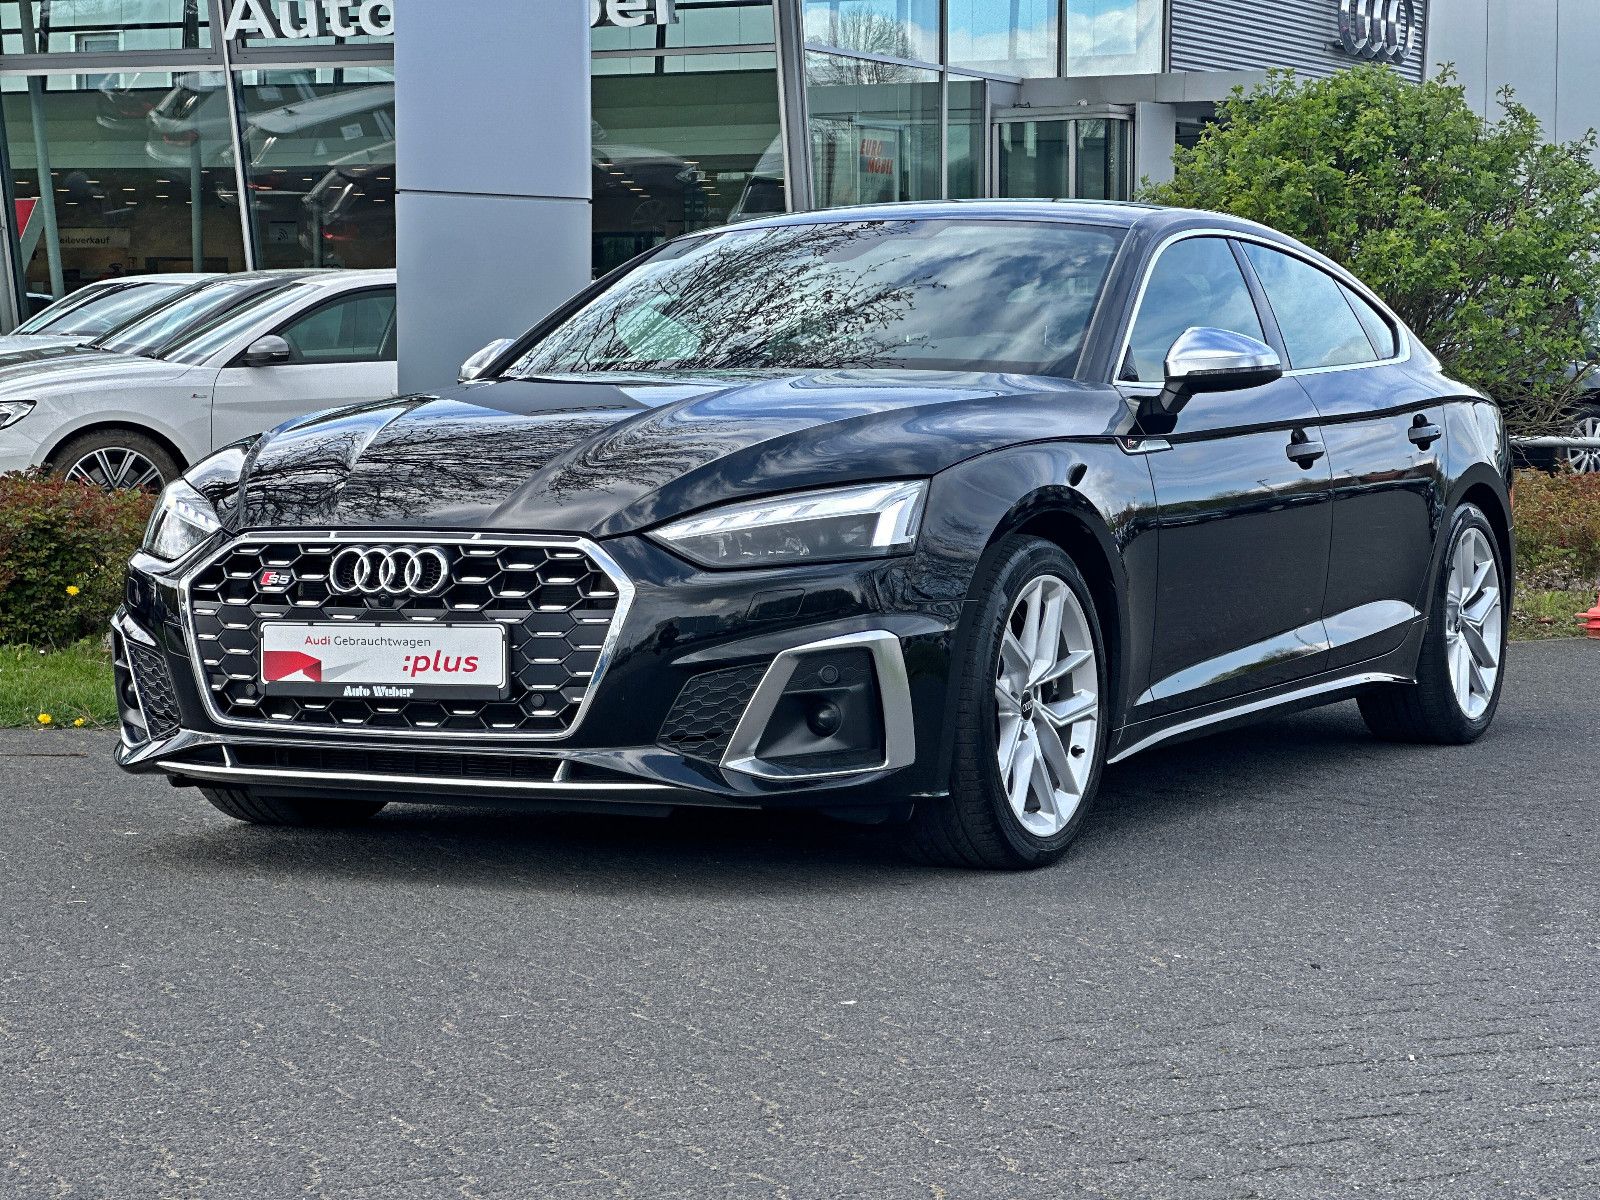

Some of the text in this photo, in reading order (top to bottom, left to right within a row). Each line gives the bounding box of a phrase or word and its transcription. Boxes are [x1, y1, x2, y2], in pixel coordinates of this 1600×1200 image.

[223, 0, 394, 40] Auto
[59, 236, 110, 245] eileverkauf
[304, 636, 431, 649] Audi Gebrauchtwagen
[343, 686, 414, 698] Auto Weber
